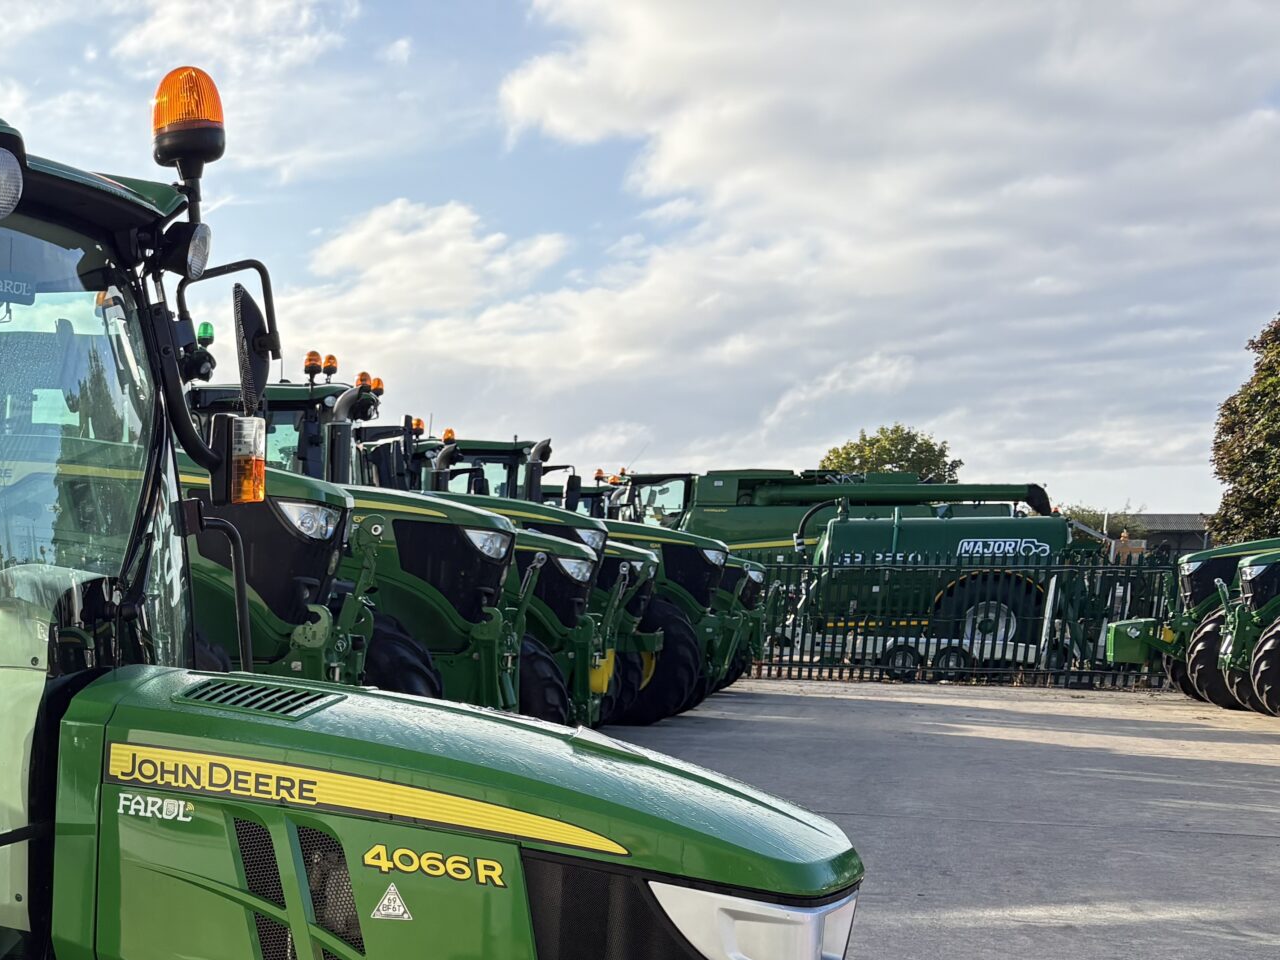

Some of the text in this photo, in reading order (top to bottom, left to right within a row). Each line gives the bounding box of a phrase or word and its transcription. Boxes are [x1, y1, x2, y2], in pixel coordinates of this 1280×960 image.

[961, 541, 1016, 553] MAJOR
[121, 753, 318, 802] JOHN DEERE
[117, 793, 192, 822] FAROL
